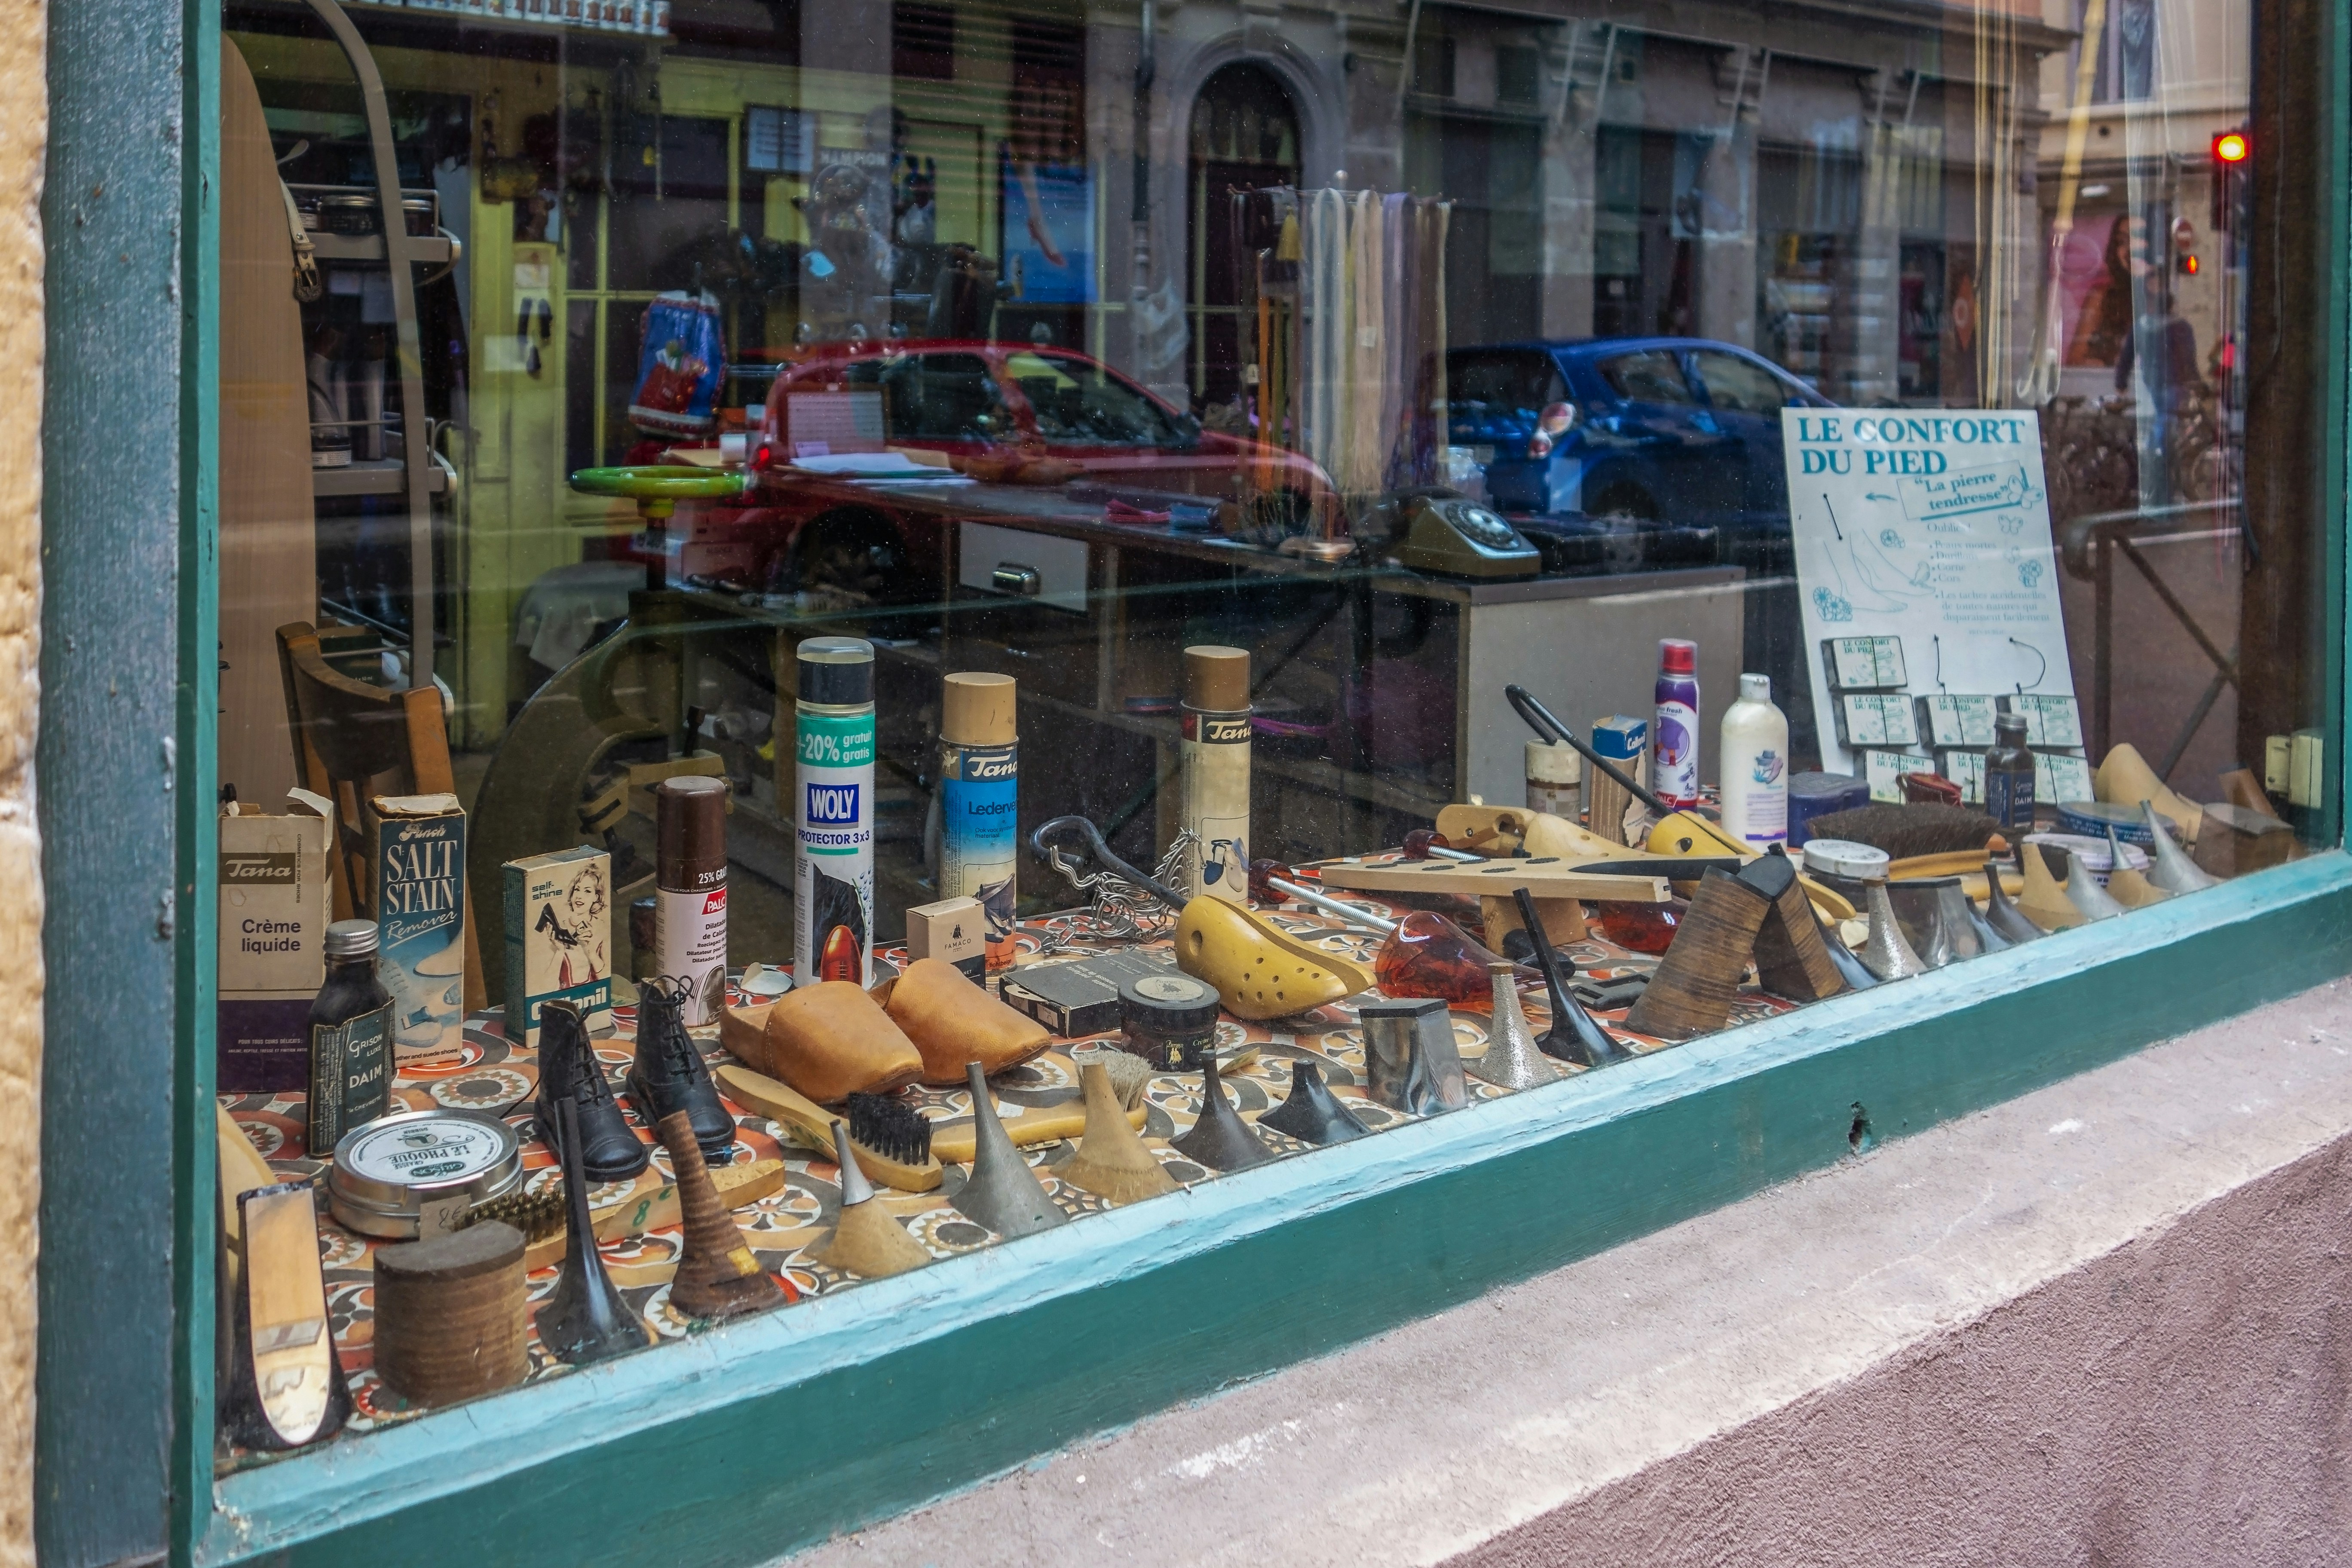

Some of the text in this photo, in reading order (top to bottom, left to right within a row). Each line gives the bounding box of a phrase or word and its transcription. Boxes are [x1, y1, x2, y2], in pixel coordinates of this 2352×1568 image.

[1798, 417, 2025, 444] LE CONFORT
[1802, 450, 1947, 475] DU PIED
[1951, 473, 1997, 493] pierre
[1927, 522, 1965, 532] Oublie
[1936, 551, 1975, 560] Durillon
[1959, 591, 1988, 599] taches
[1991, 590, 2046, 599] accidentelles
[1942, 601, 1952, 610] de
[2023, 603, 2037, 612] qui
[1943, 612, 2050, 623] disparaissent facilement
[797, 733, 840, 761] +20%
[843, 730, 872, 747] gratuit
[843, 747, 870, 763] gratis
[812, 788, 854, 820] WOLY
[2015, 796, 2032, 805] DAIM
[798, 828, 870, 845] PROTECTOR 3x3
[226, 858, 291, 878] Tana
[387, 840, 457, 883] SALT
[698, 872, 715, 884] 25%
[532, 882, 554, 893] self-
[532, 888, 563, 900] shine
[387, 878, 457, 916] STAIN
[707, 894, 726, 913] PALC
[242, 919, 301, 934] Crème
[385, 910, 458, 940] Remover
[242, 937, 301, 955] liquide
[944, 938, 971, 949] FAMACO
[349, 1033, 383, 1058] GRISON
[367, 1044, 382, 1057] LUXE
[349, 1063, 383, 1089] DAIM
[389, 1144, 470, 1164] LE PHOQUE
[392, 1160, 423, 1170] GRAISSE
